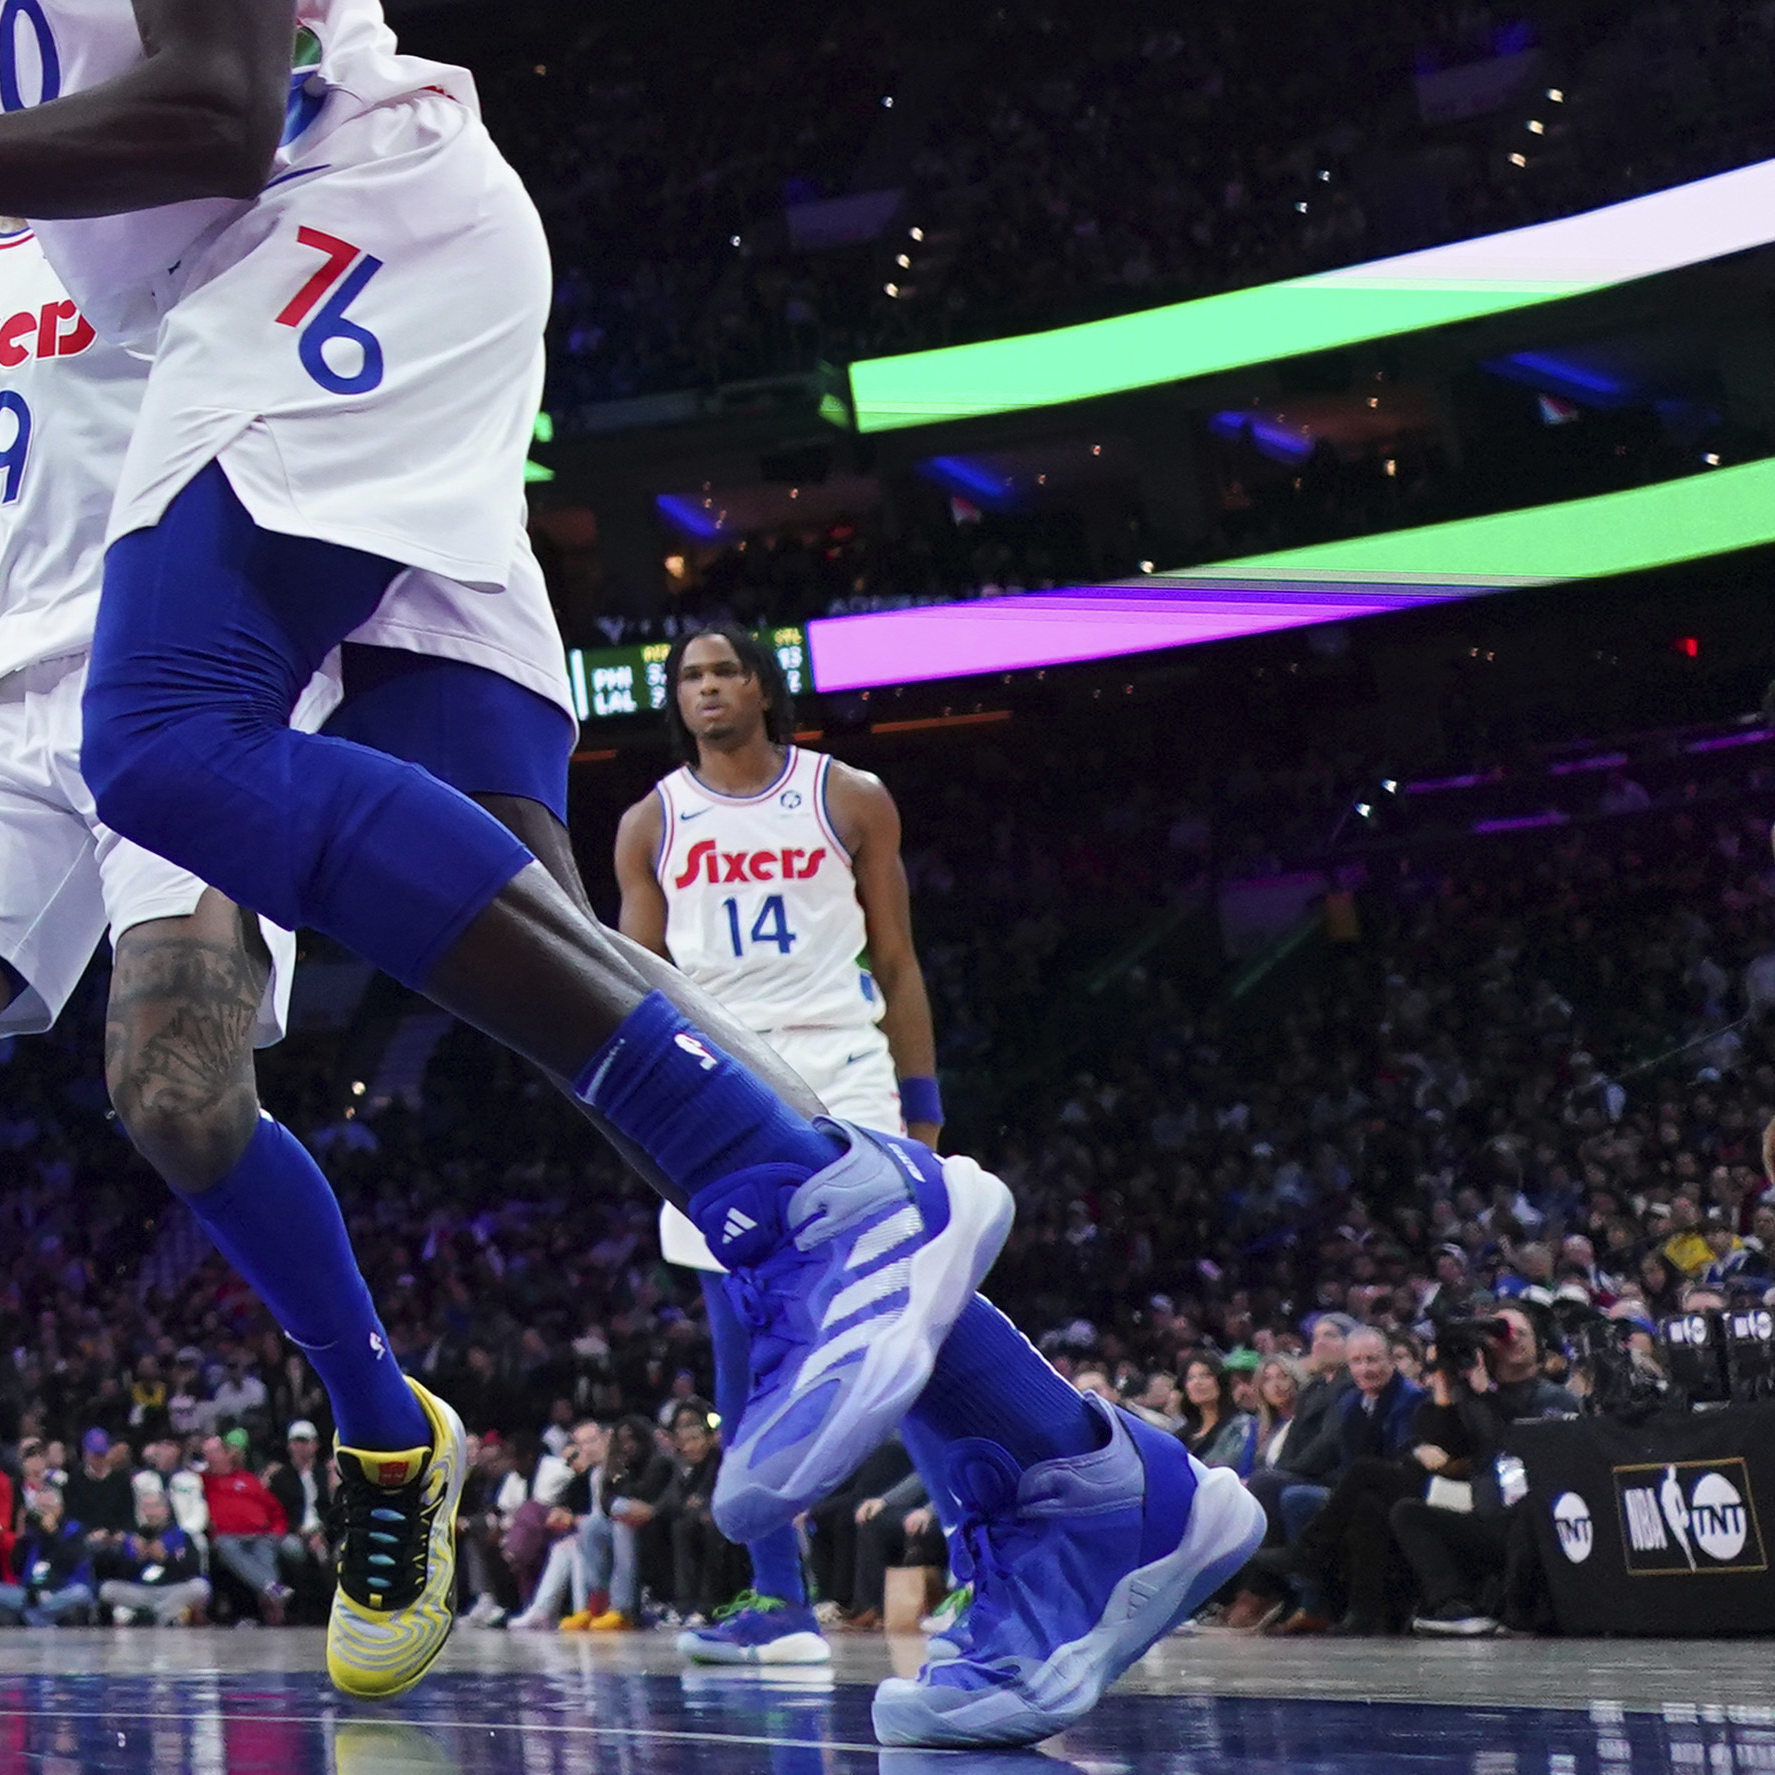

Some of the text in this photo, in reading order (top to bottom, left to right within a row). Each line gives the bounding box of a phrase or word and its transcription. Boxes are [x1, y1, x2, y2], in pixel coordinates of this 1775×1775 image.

[274, 225, 385, 396] 76
[592, 665, 634, 693] PHI
[593, 689, 638, 717] LAL
[675, 839, 826, 890] Sixers
[724, 895, 796, 958] 14
[1689, 1503, 1745, 1536] TNT
